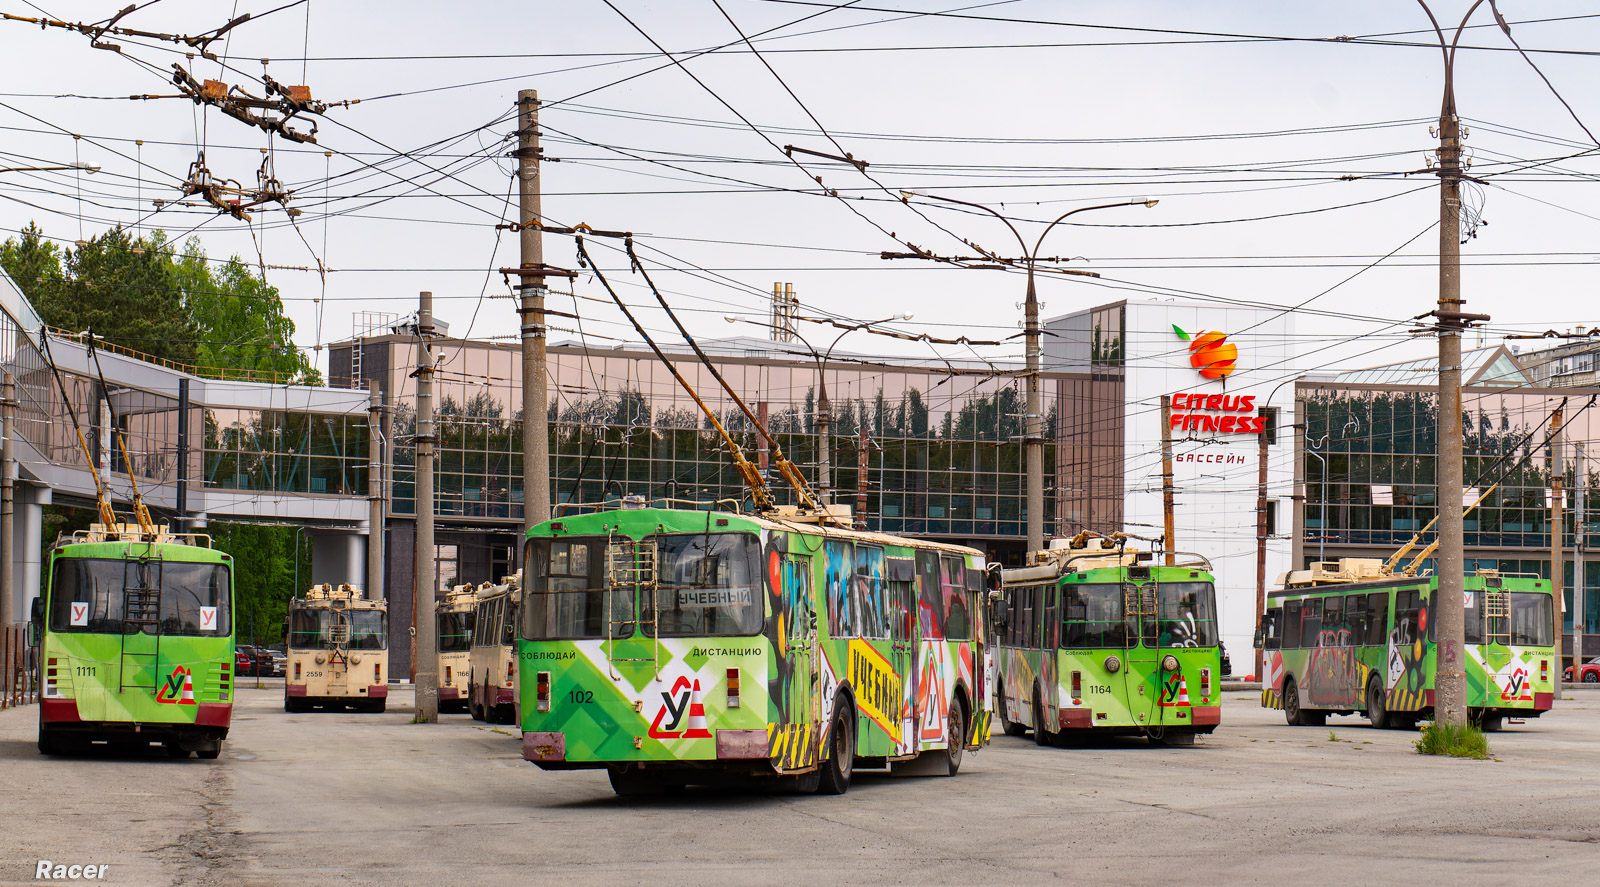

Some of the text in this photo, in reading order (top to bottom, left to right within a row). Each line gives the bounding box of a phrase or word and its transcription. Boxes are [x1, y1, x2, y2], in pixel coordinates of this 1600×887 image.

[1171, 393, 1256, 412] CITRUS
[520, 647, 762, 660] СОБЛЮДАЙ ДИСТАНЦИЮ
[76, 666, 96, 677] 1111
[1090, 685, 1111, 694] 1164
[569, 690, 594, 704] 102
